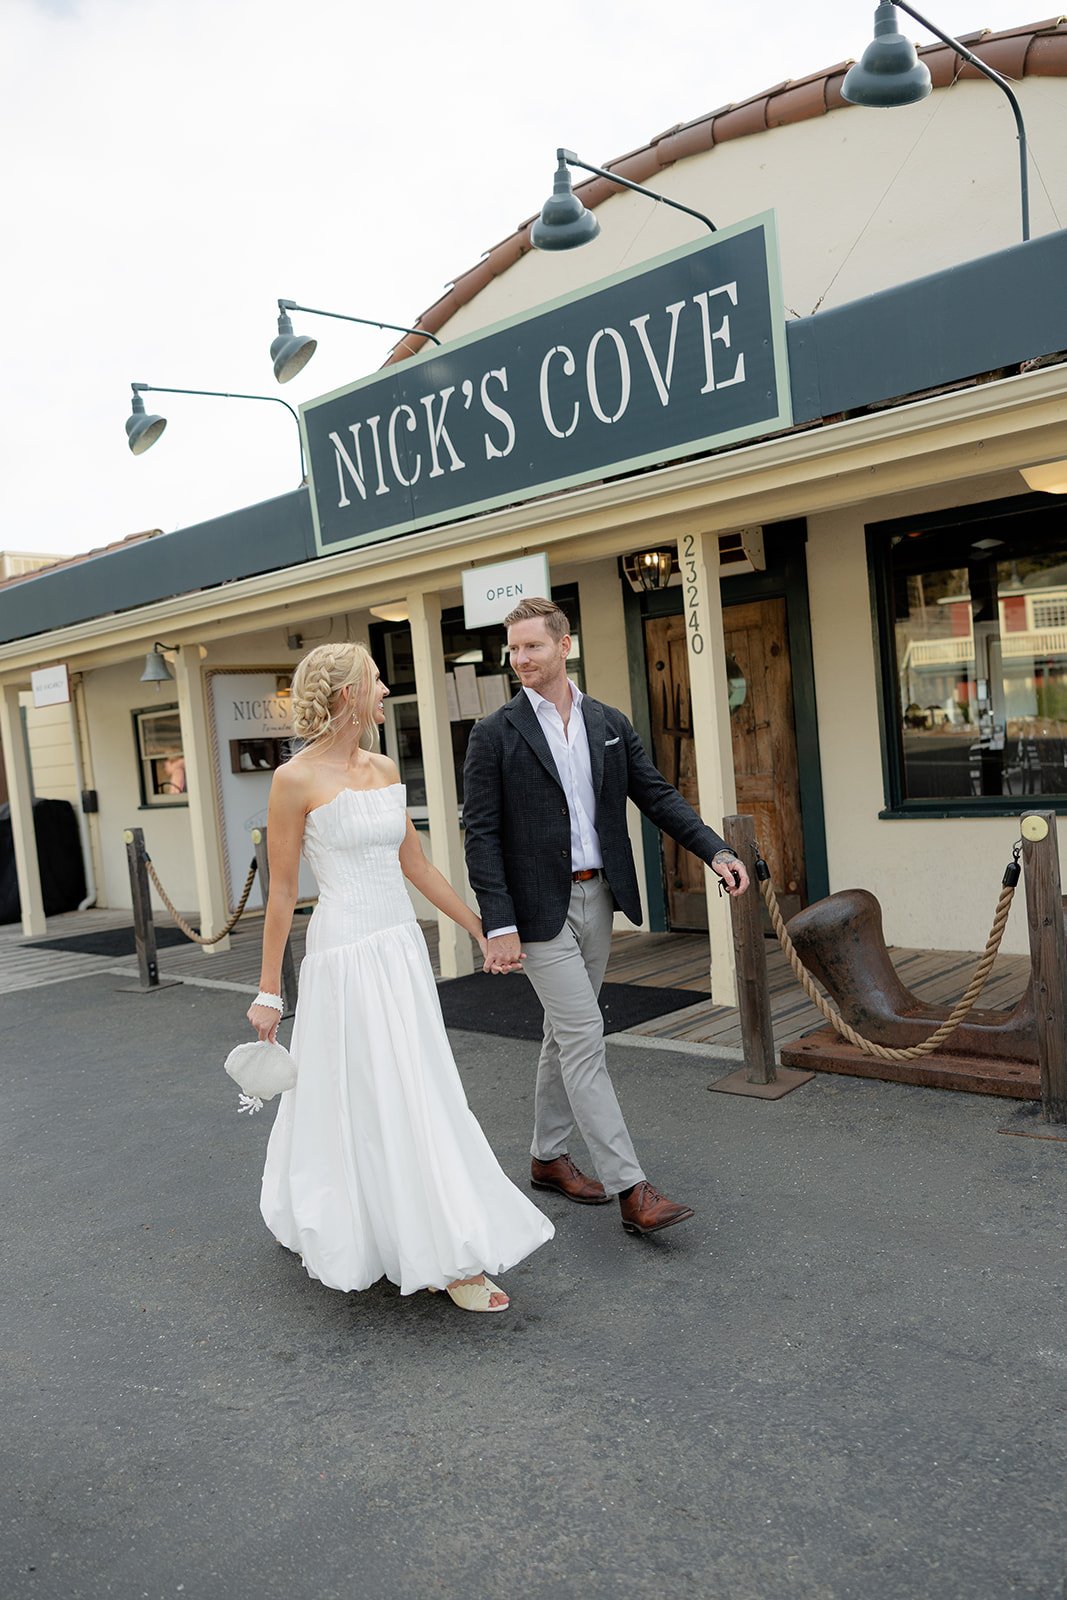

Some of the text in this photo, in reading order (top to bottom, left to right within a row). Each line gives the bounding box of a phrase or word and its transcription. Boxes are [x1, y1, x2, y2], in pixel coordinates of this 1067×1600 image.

[328, 281, 746, 508] NICK'S COVE
[486, 584, 523, 601] OPEN
[683, 534, 704, 655] 23240
[232, 700, 288, 721] NICK'S
